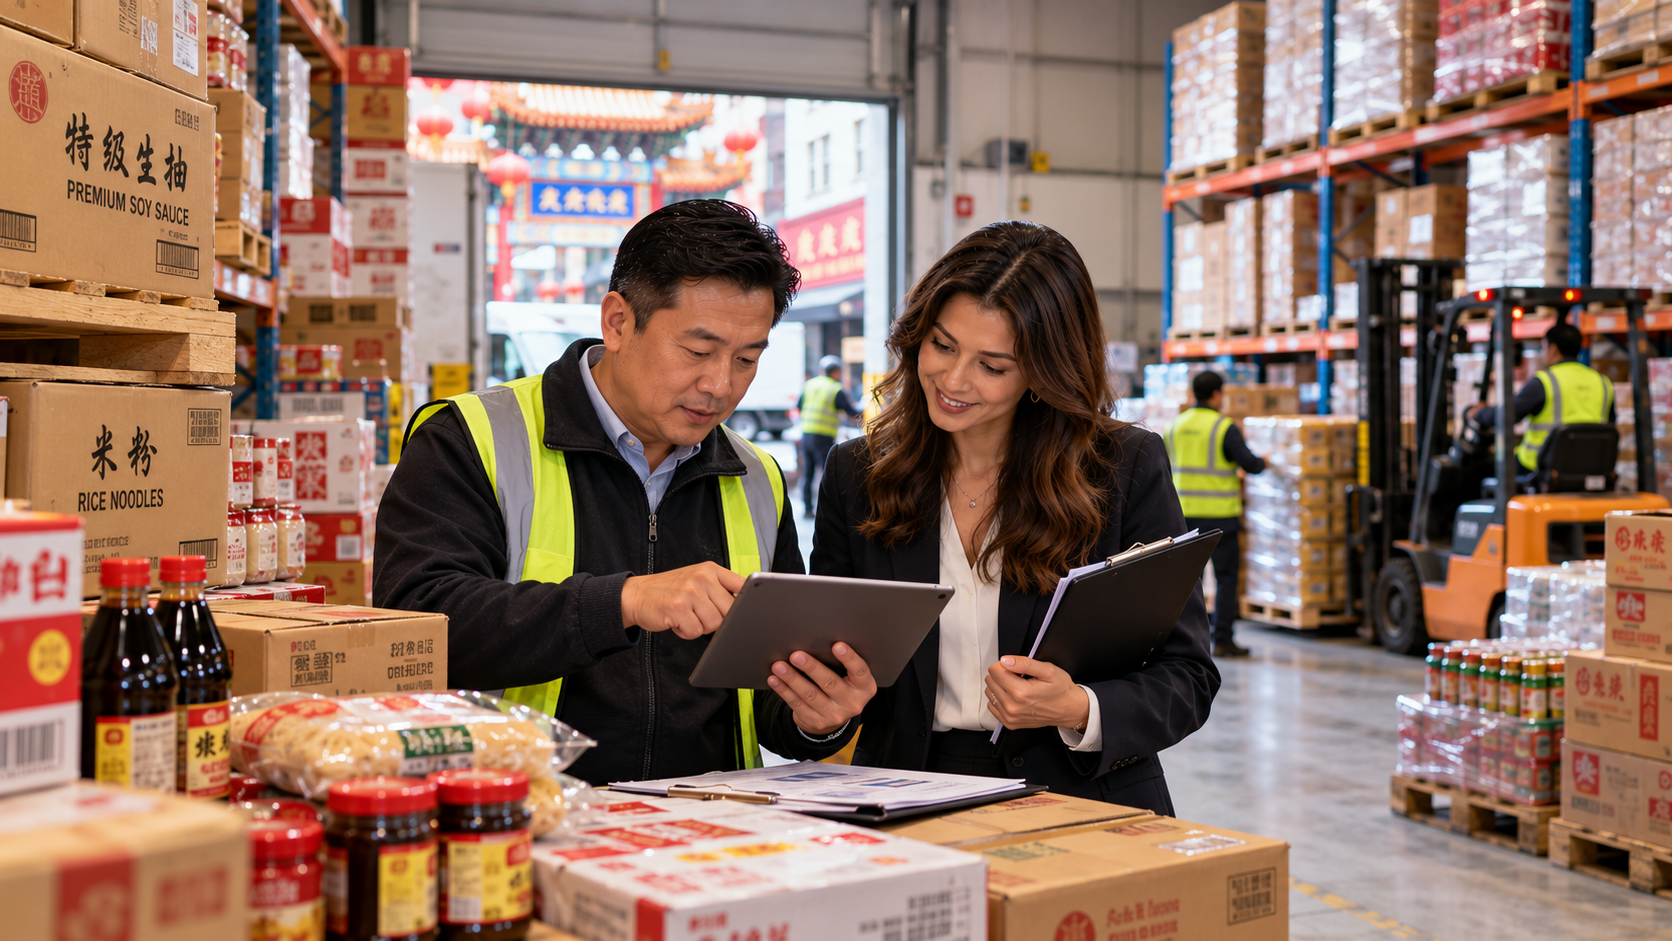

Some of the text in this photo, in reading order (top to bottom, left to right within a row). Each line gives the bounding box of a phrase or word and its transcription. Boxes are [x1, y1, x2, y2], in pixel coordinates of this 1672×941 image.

[65, 112, 188, 193] 特级生抽
[67, 179, 189, 226] PREMIUM SOY SAUCE
[91, 424, 158, 481] 米粉
[78, 488, 164, 512] RICE NOODLES
